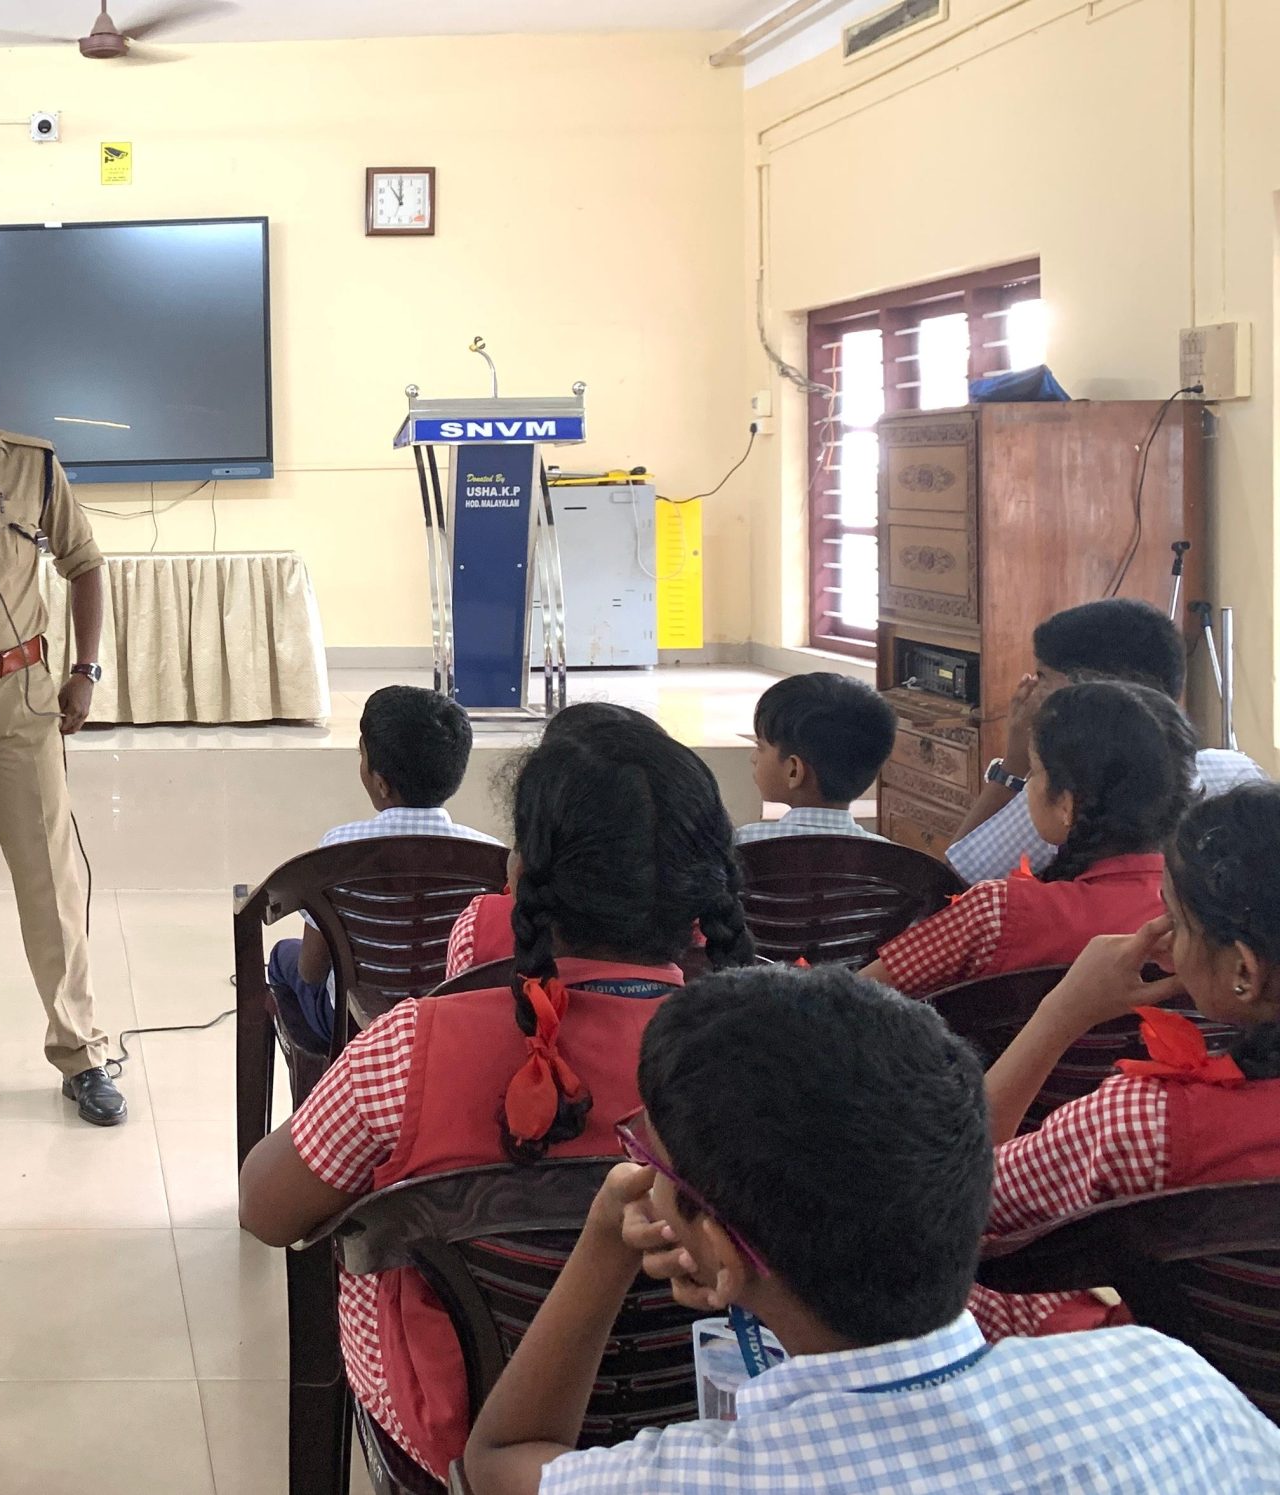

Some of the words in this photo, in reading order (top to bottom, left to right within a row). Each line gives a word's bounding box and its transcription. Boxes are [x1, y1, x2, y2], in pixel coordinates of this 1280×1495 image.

[440, 421, 557, 438] SNVM
[466, 473, 494, 483] Donated
[495, 473, 506, 484] By
[746, 1325, 767, 1372] VIDYA
